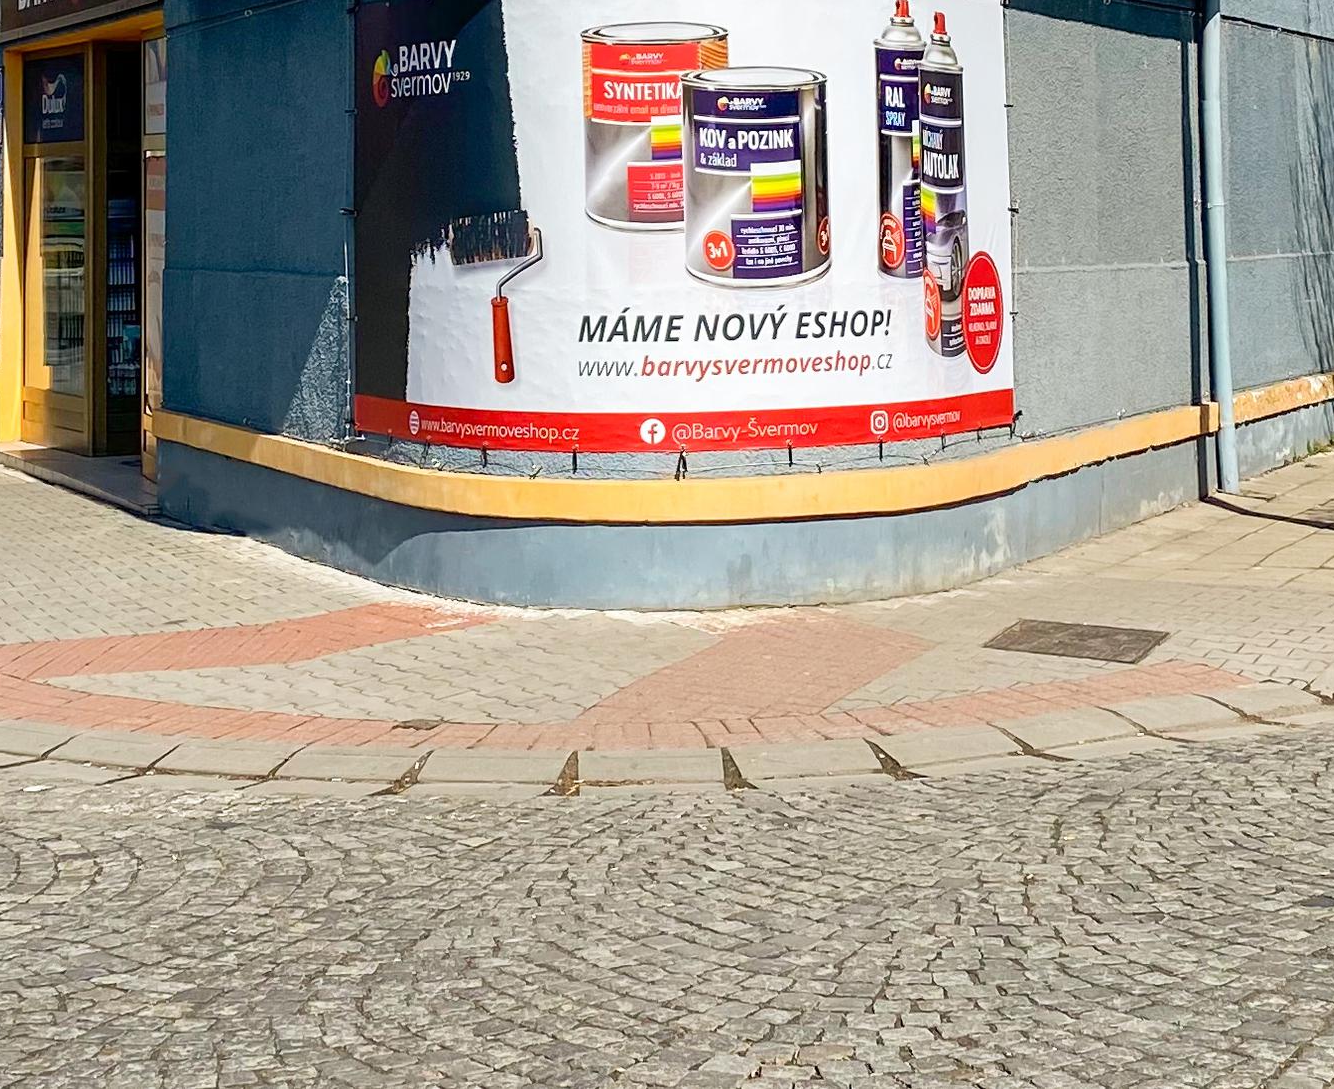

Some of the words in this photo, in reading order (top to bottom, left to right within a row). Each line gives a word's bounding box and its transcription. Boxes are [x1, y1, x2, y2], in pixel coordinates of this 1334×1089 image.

[398, 39, 457, 73] BARVY
[452, 71, 471, 82] 1929
[41, 94, 64, 114] Dulux
[884, 85, 906, 108] RAL
[885, 110, 906, 127] SPRAY
[699, 127, 727, 149] KOV
[727, 137, 737, 150] a
[737, 128, 794, 150] POZINK
[700, 152, 707, 165] &
[708, 151, 737, 167] základ
[922, 150, 959, 179] AUTOLAK
[707, 240, 729, 259] 3v1
[968, 286, 996, 301] DOPRAVA
[969, 302, 996, 317] ZDARMA
[578, 307, 684, 343] MÁME
[694, 304, 788, 342] NOVÝ
[795, 309, 892, 339] ESHOP!
[578, 350, 893, 382] www.barvysvermoveshop.cz
[421, 417, 580, 444] www.barvysvermoveshop.cz
[671, 416, 818, 445] @Barvy-Švermov
[892, 411, 961, 433] @barvysvermov
